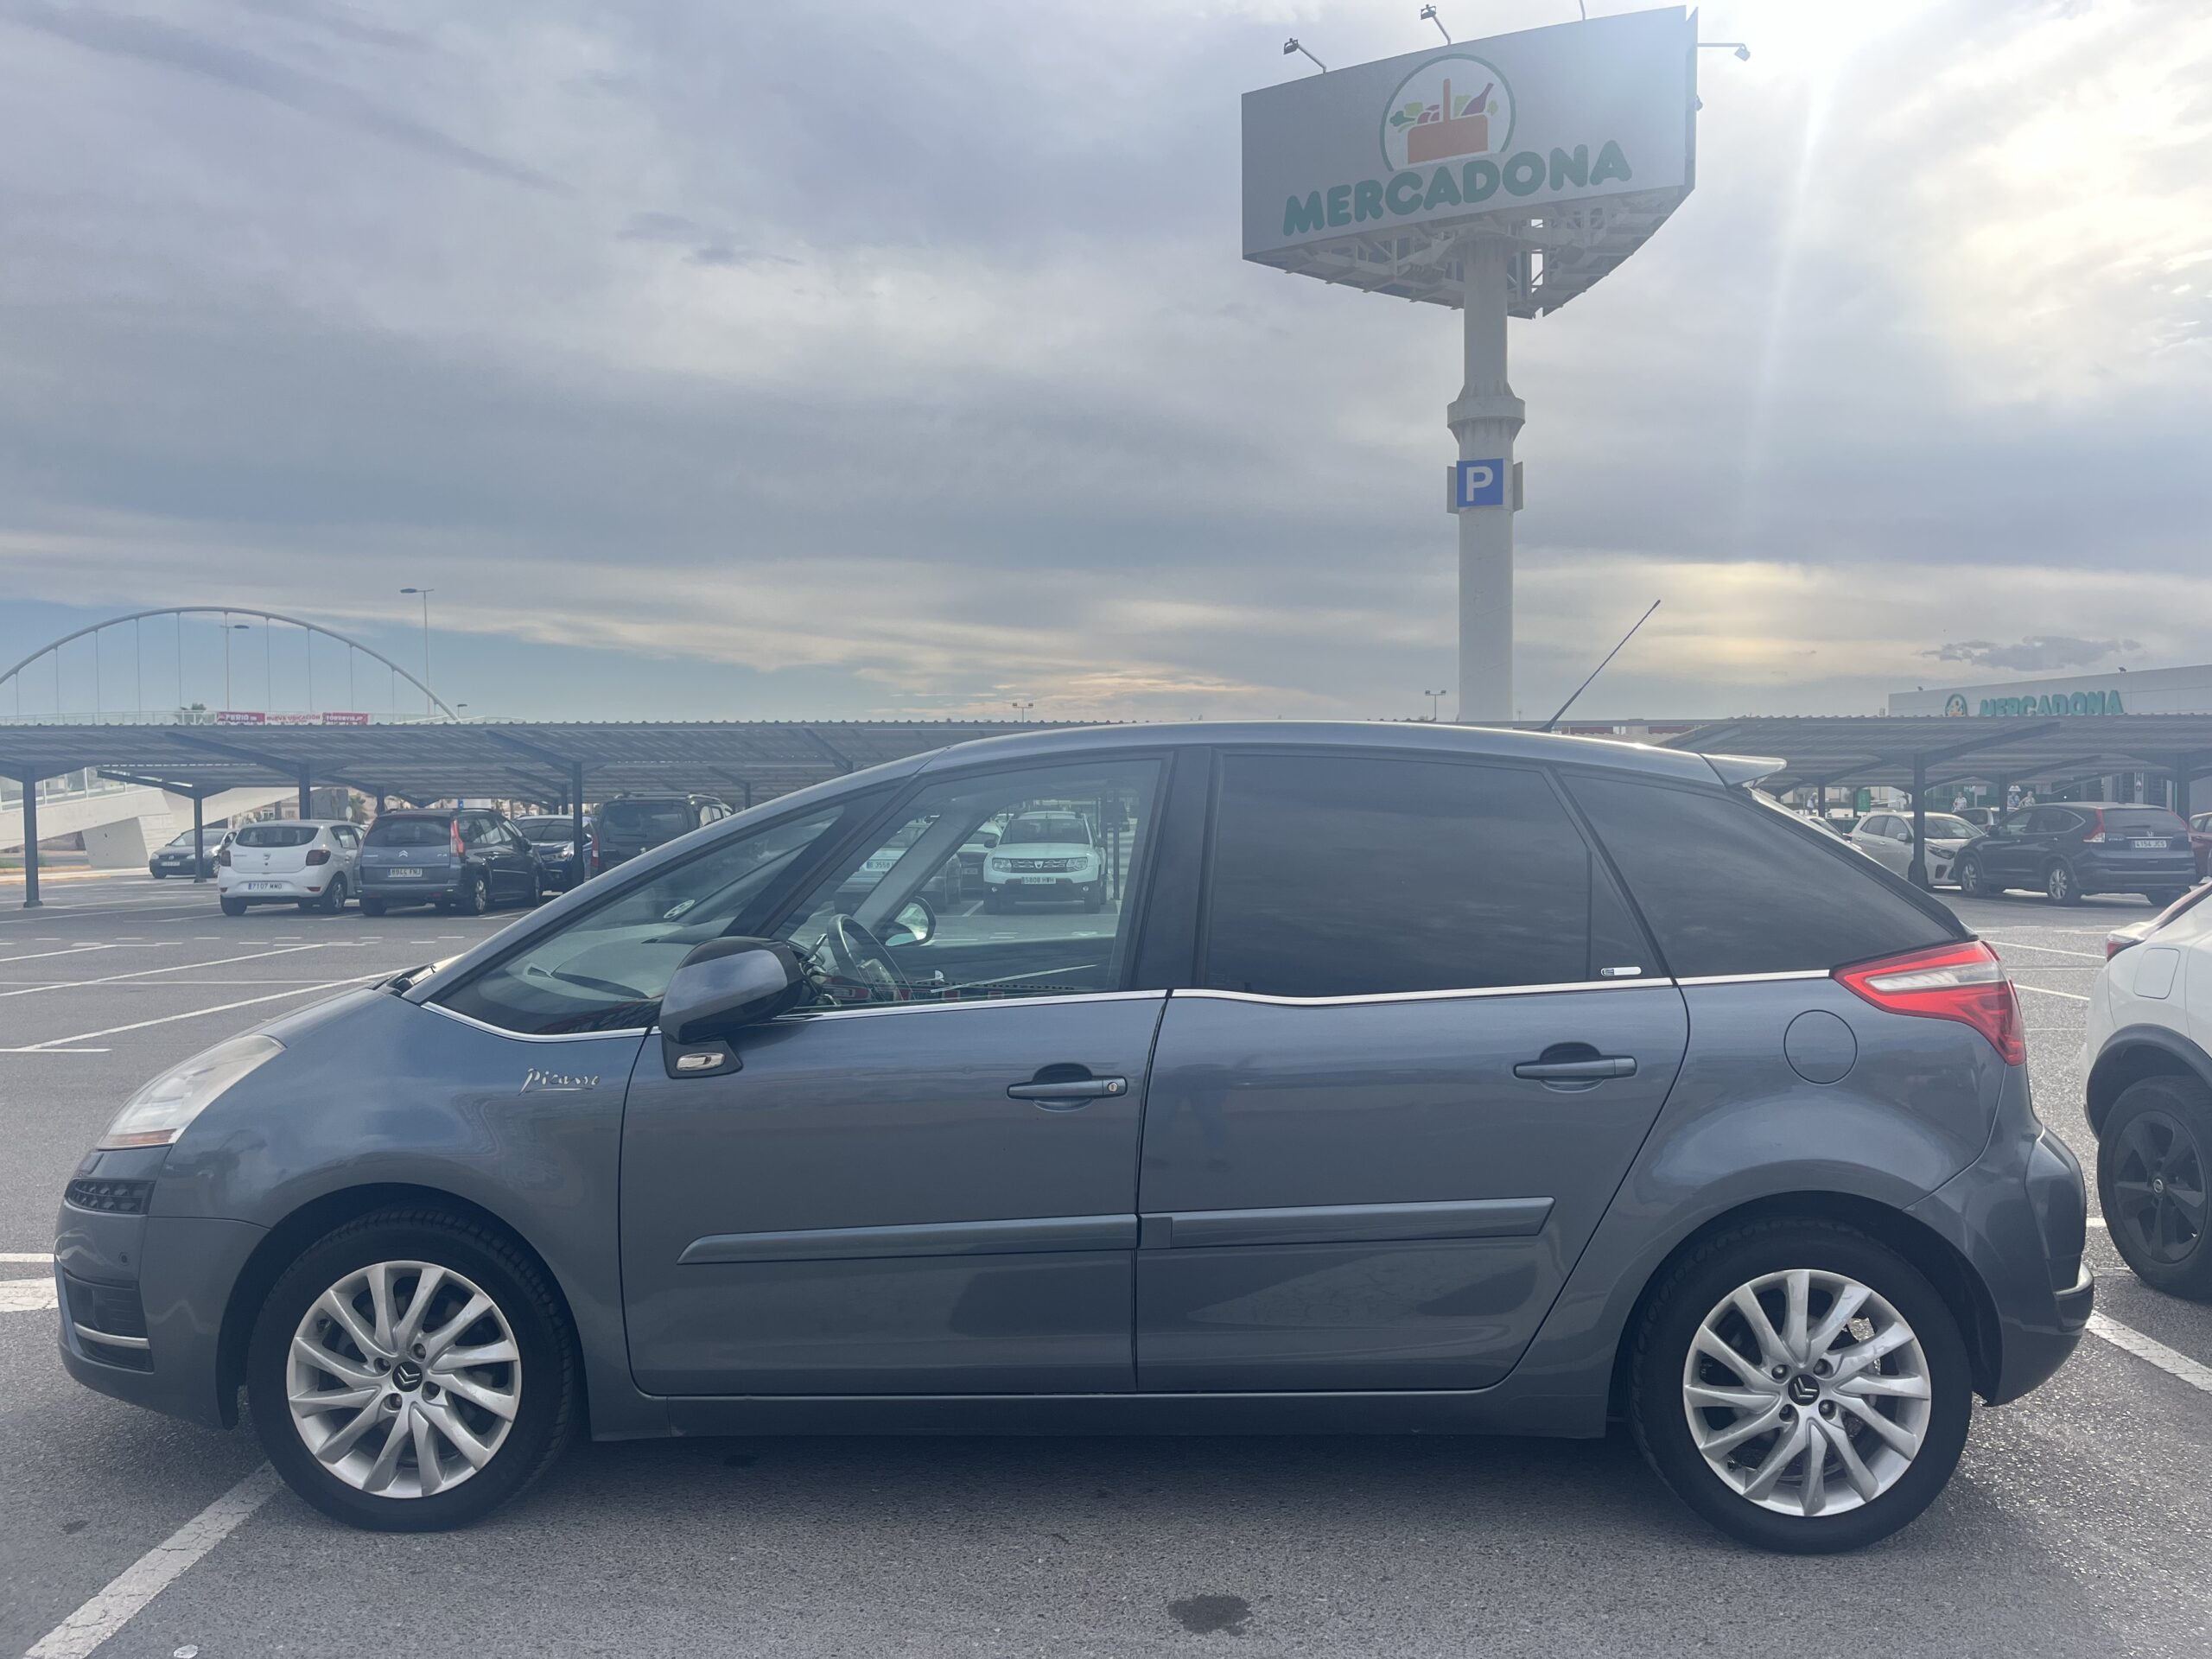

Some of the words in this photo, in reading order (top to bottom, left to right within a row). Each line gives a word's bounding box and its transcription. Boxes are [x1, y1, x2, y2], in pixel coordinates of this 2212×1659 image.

[1283, 139, 1632, 236] MERCADONA
[1465, 466, 1494, 502] P
[1980, 690, 2124, 716] MERCADONA
